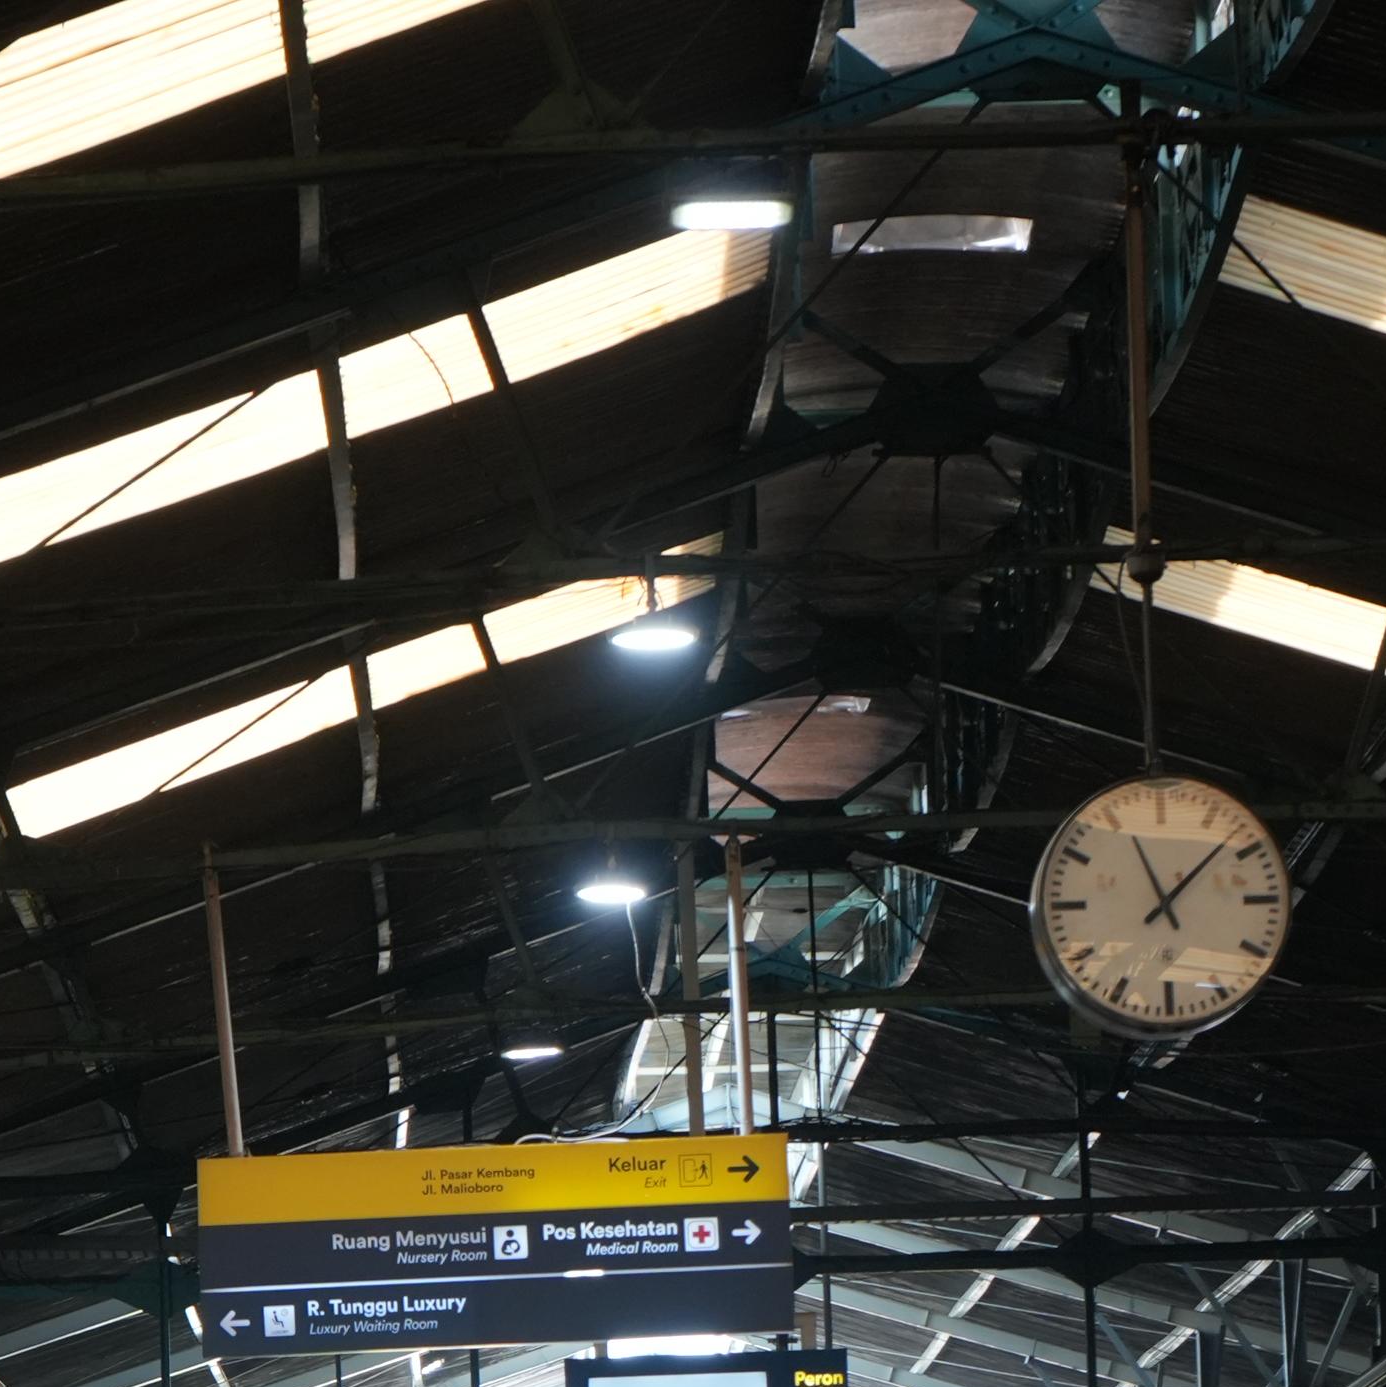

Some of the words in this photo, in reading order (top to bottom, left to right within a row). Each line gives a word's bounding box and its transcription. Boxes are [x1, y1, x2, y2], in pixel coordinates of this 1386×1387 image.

[608, 1156, 666, 1173] Keluar
[421, 1169, 436, 1182] Jl.
[440, 1168, 473, 1180] Pasar
[476, 1166, 535, 1180] Kembang
[421, 1184, 436, 1196] Jl.
[440, 1182, 503, 1194] Malioboro
[644, 1177, 667, 1189] Exit
[331, 1232, 390, 1251] Ruang
[396, 1226, 487, 1249] Menyusui
[542, 1224, 576, 1241] Pos
[580, 1219, 678, 1240] Kesehatan
[585, 1241, 639, 1257] Medical
[642, 1239, 679, 1253] Room
[396, 1250, 448, 1266] Nursery
[451, 1249, 488, 1261] Room
[307, 1300, 325, 1317] R.
[329, 1298, 398, 1318] Tunggu
[403, 1295, 467, 1314] Luxury
[309, 1321, 351, 1336] Luxury
[353, 1317, 400, 1334] Waiting
[403, 1317, 439, 1331] Room
[794, 1370, 845, 1387] Peron
